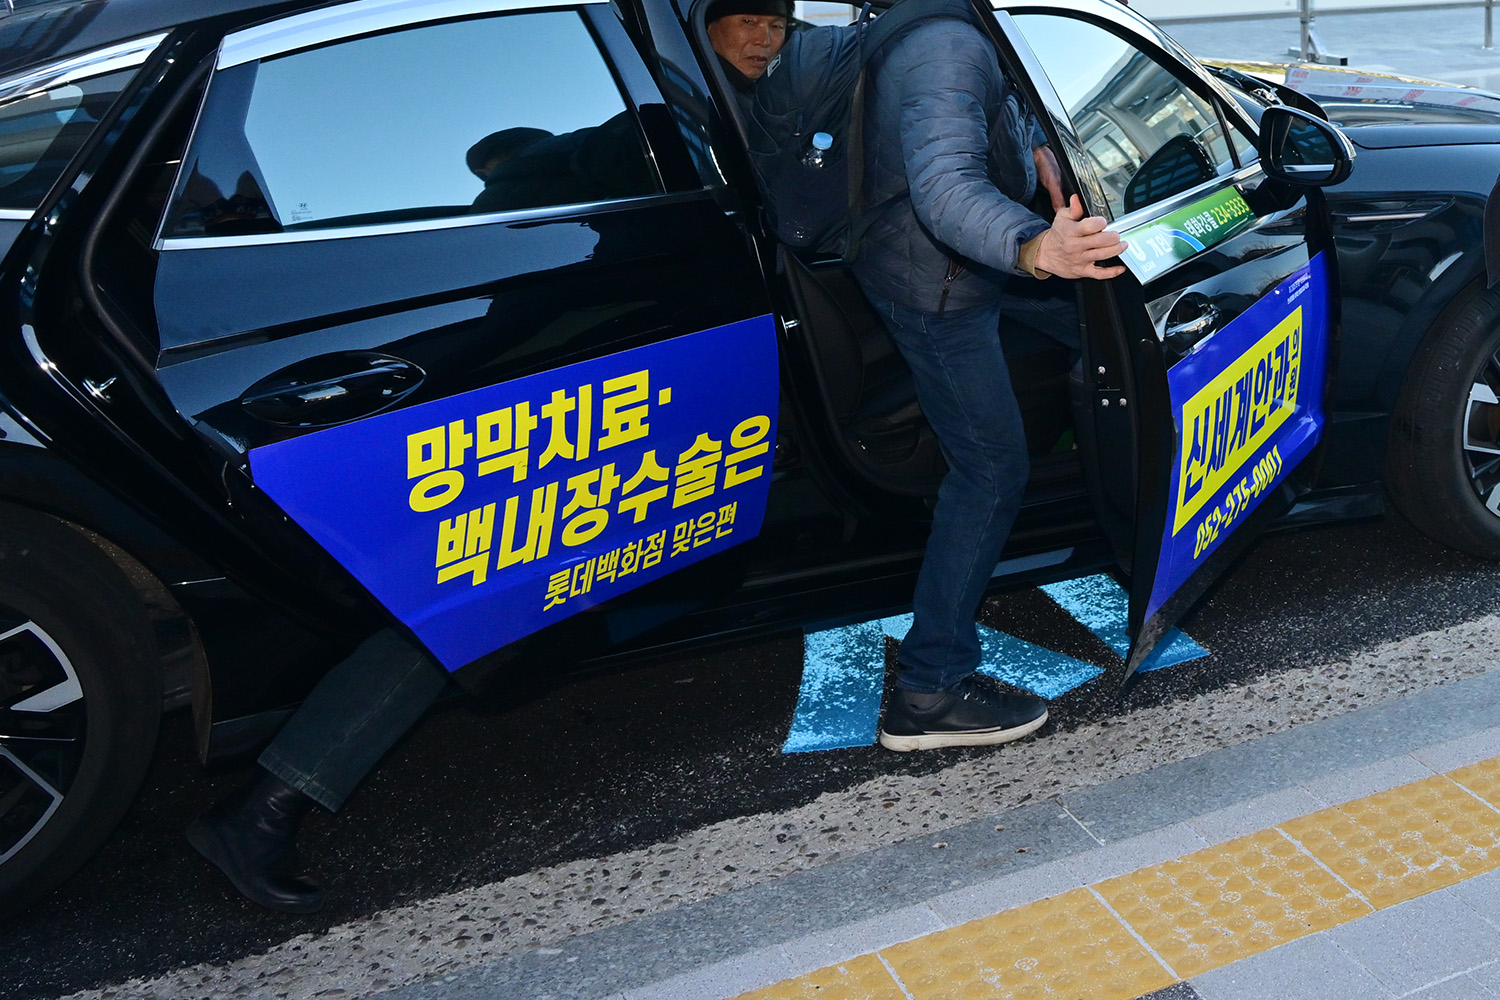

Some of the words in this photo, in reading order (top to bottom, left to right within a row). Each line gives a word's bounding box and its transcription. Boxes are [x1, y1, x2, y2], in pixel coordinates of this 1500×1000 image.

[1210, 196, 1250, 226] 234-3333
[1183, 334, 1290, 508] 신세계안과
[435, 414, 771, 586] 백내장수술은
[543, 529, 666, 612] 롯데백화점
[670, 501, 738, 558] 맞은편
[1193, 444, 1283, 560] 052-275-0001
